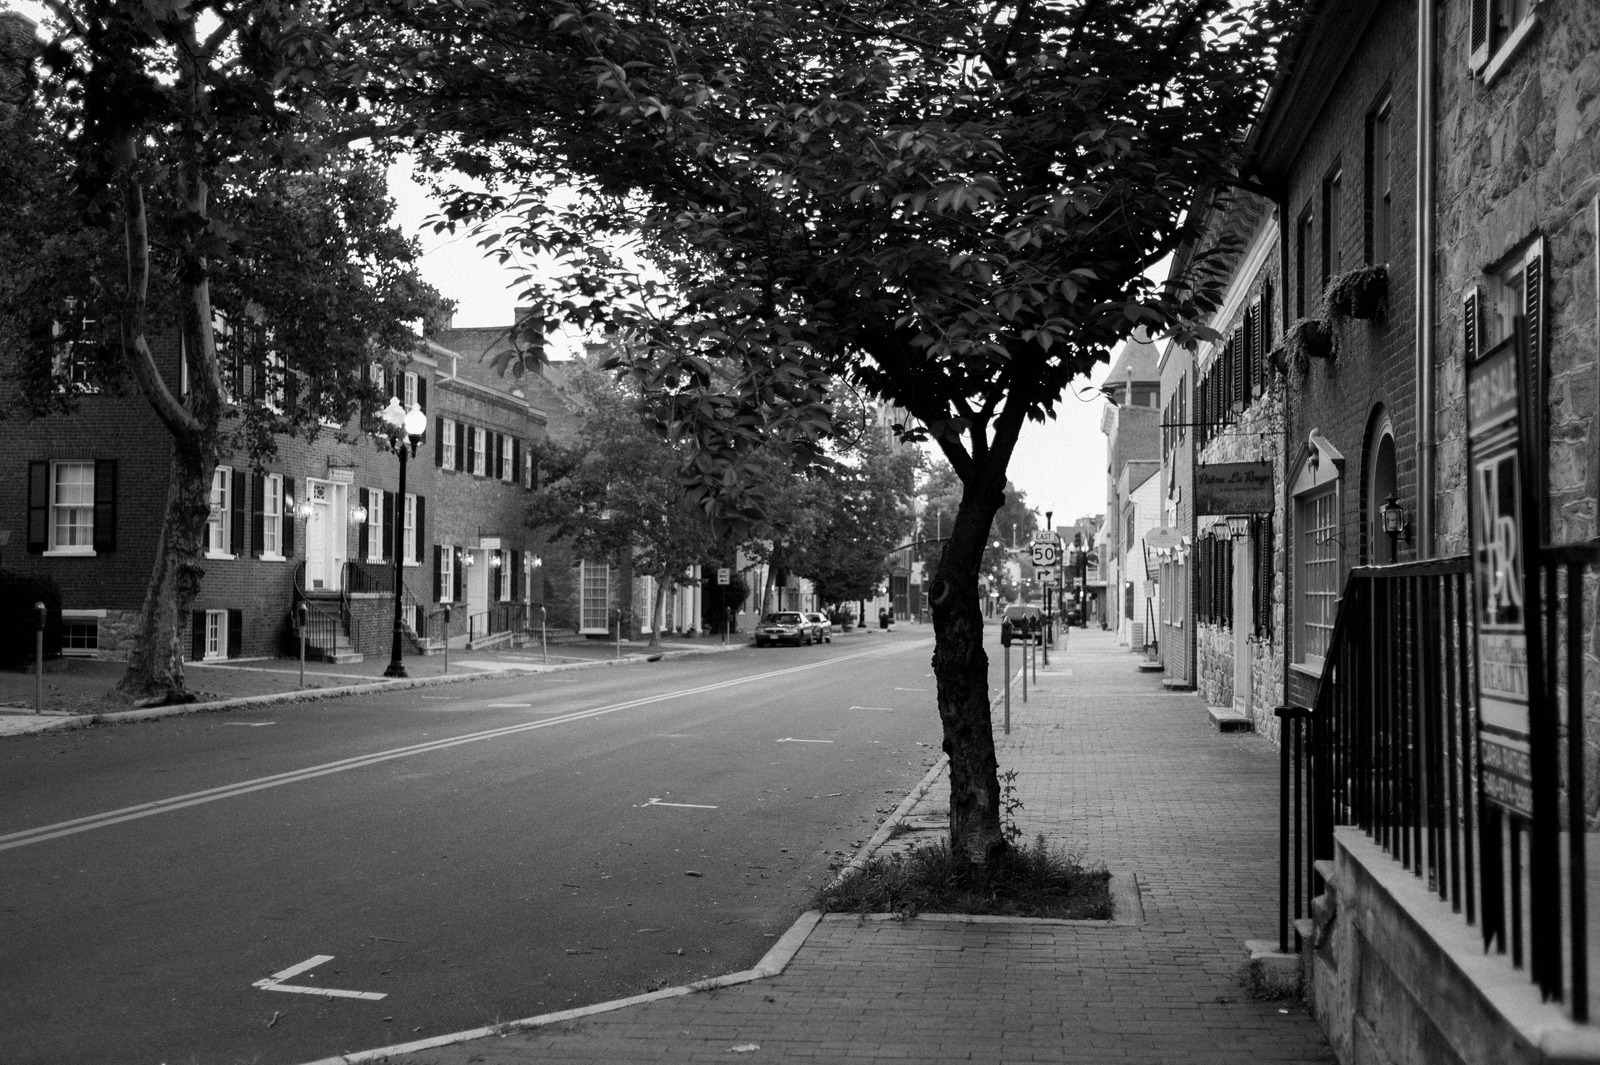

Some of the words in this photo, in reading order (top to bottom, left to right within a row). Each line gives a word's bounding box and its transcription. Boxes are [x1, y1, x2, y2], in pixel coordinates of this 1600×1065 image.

[1469, 375, 1490, 421] FOR
[1490, 356, 1517, 408] SALE
[1227, 471, 1242, 484] La
[1036, 533, 1051, 541] EAST
[1035, 548, 1054, 561] 50
[1482, 662, 1528, 695] REALTY
